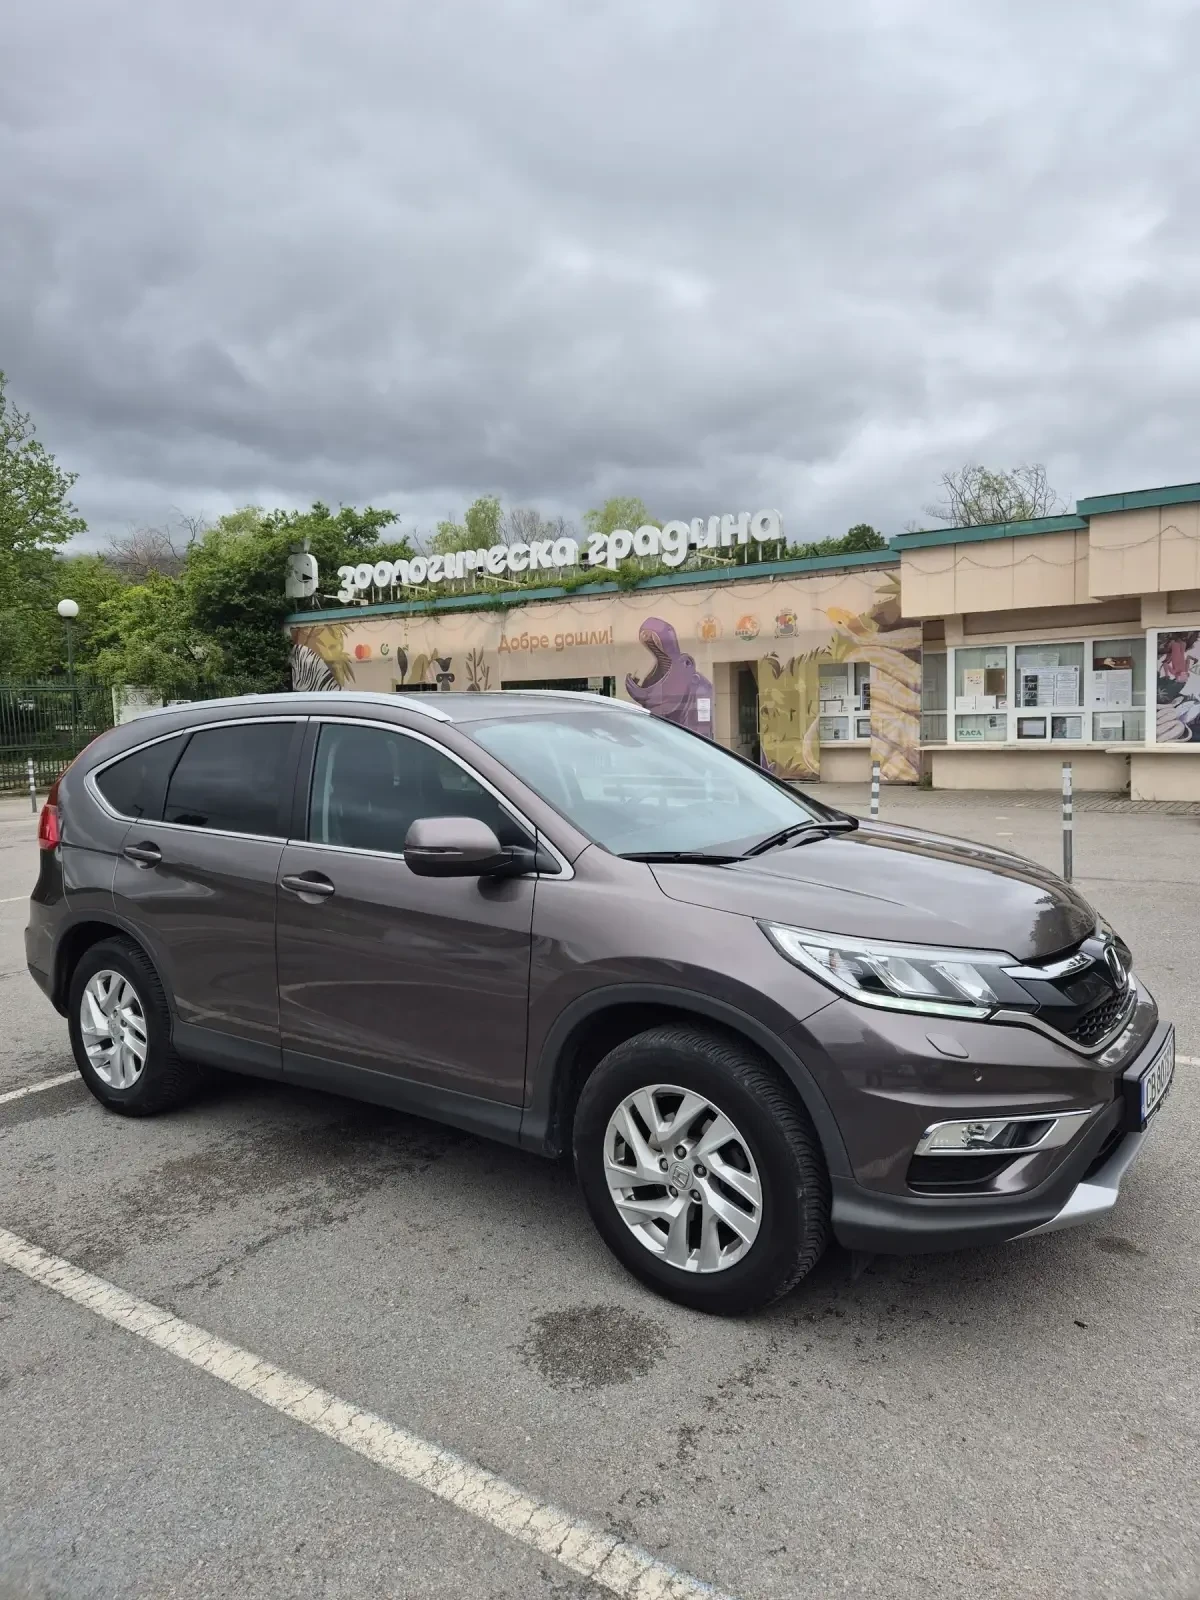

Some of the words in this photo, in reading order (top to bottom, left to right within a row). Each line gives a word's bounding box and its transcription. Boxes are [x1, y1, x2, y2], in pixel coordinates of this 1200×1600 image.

[337, 538, 579, 603] зоологическа
[588, 508, 783, 570] градина
[498, 632, 549, 654] Добре
[555, 626, 613, 652] дошли!
